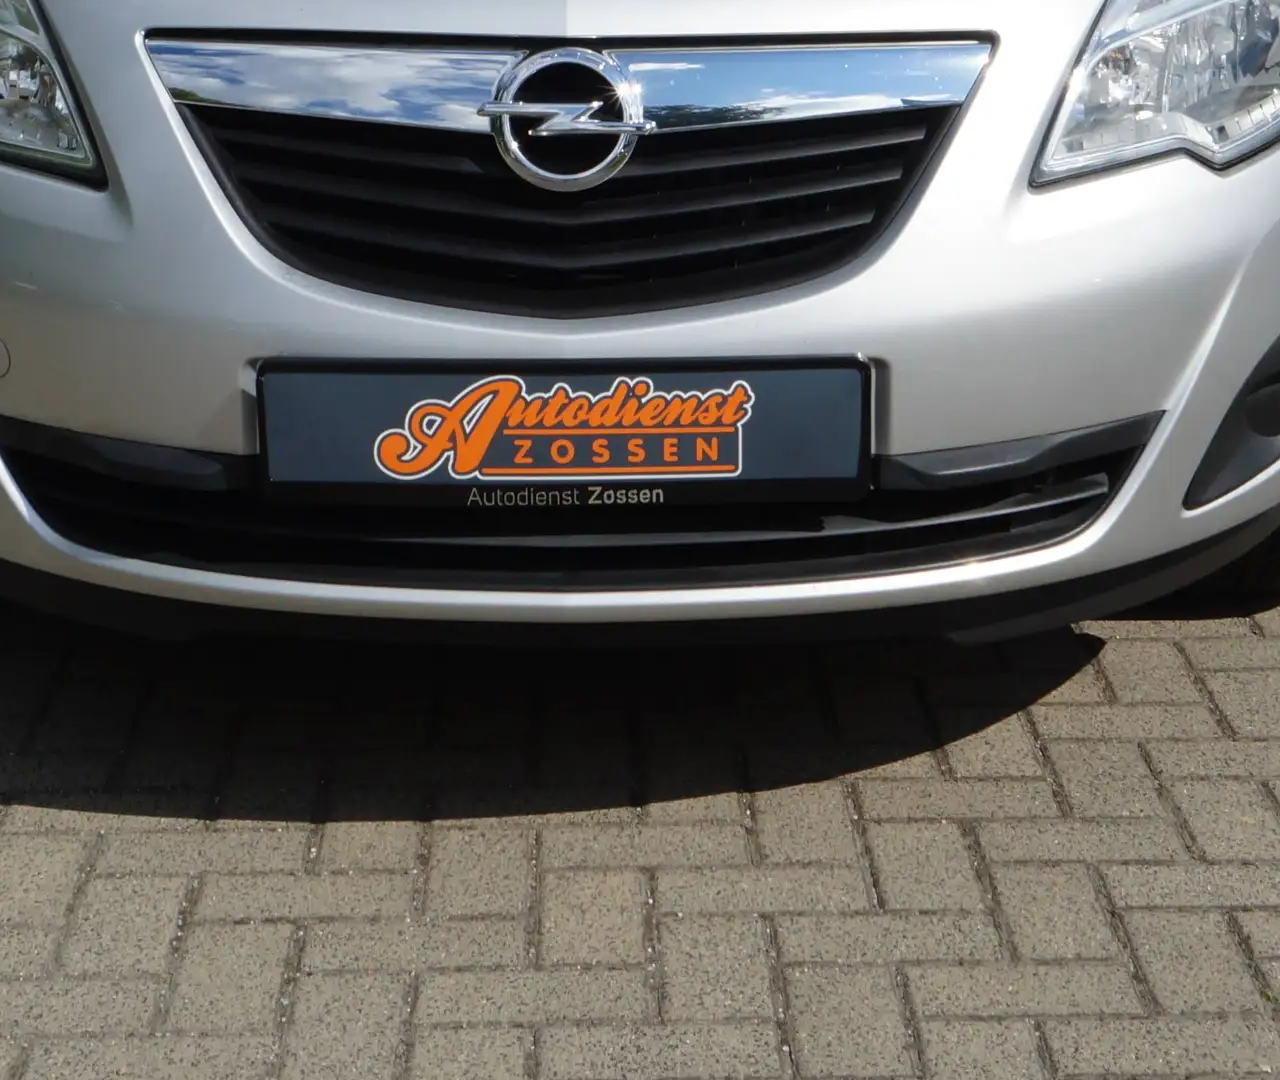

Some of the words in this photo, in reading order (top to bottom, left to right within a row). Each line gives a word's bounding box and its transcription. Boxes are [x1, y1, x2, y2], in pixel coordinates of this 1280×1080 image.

[378, 379, 749, 475] Autodienst
[513, 436, 719, 465] ZOSSEN
[466, 486, 580, 507] Autodienst
[587, 485, 664, 505] Zossen
